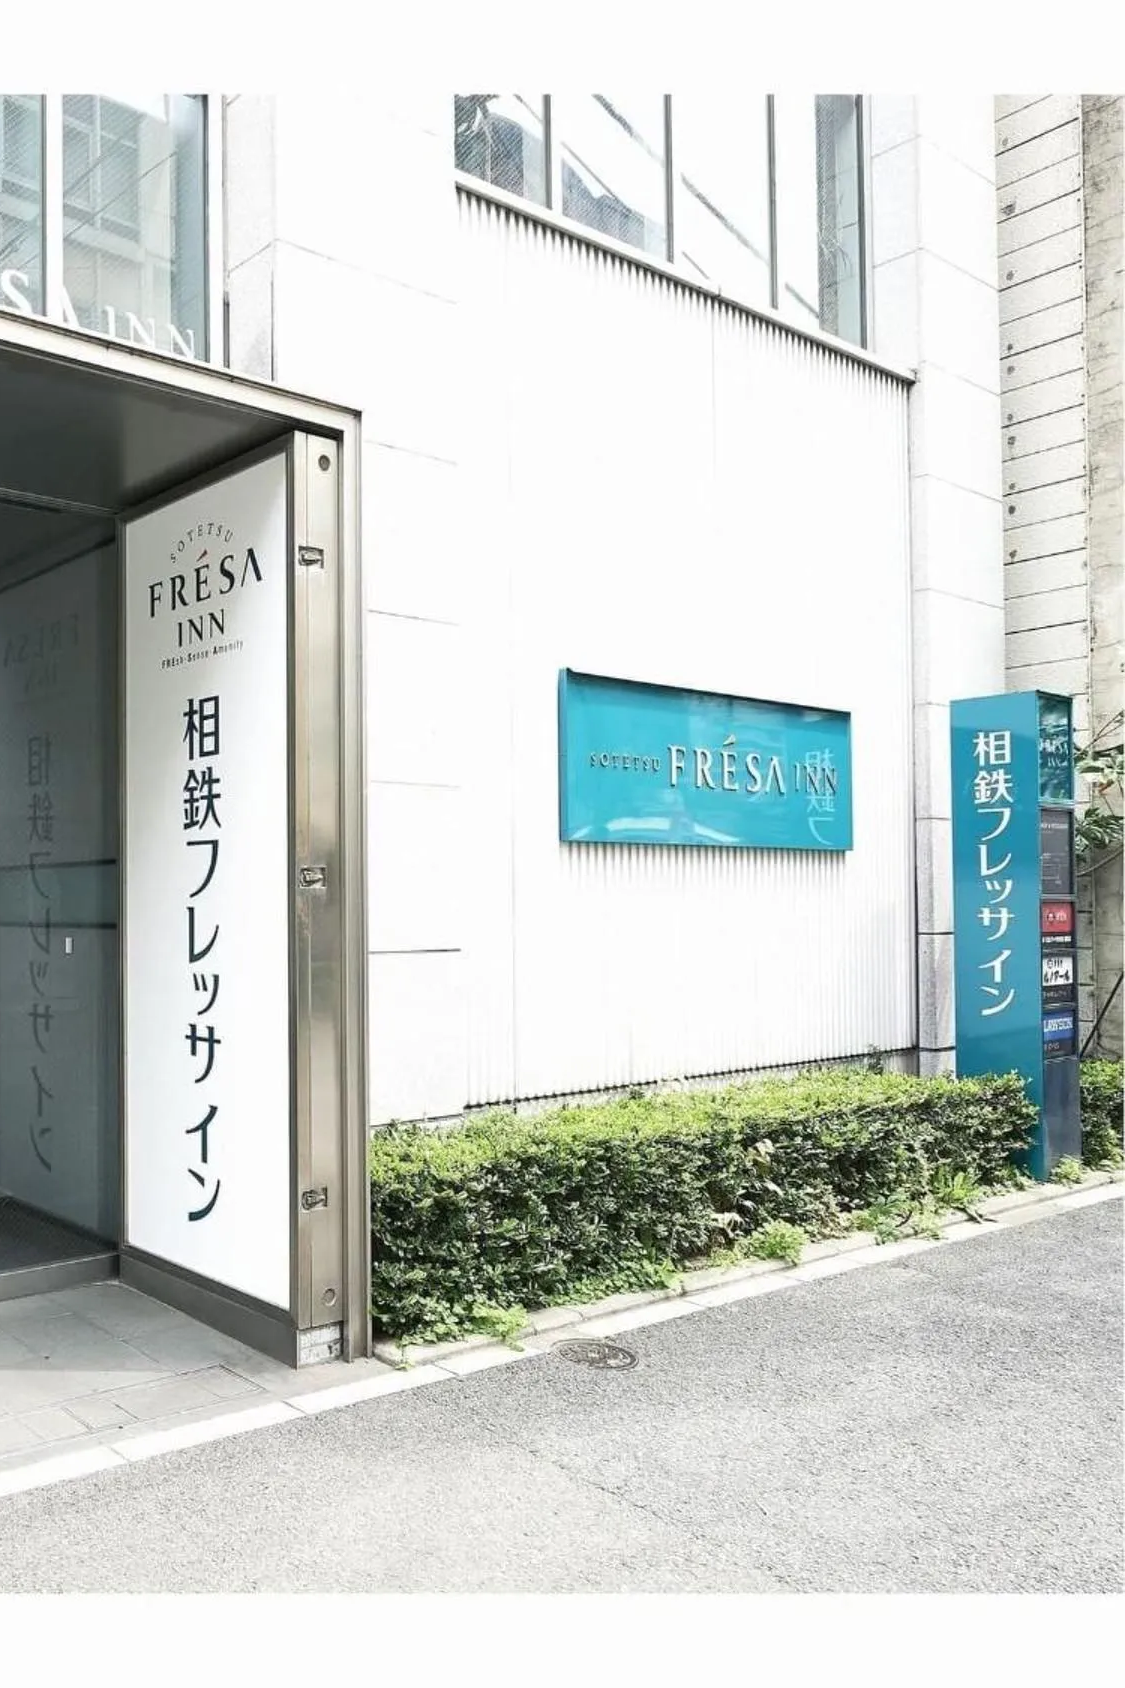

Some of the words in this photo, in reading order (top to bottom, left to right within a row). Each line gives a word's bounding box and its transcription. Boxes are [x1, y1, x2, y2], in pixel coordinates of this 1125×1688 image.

[104, 306, 197, 360] INN
[170, 522, 234, 564] SOTETSU
[147, 547, 264, 619] FRÉSA
[177, 608, 226, 648] INN
[589, 751, 661, 772] SOTETSU
[667, 734, 786, 796] FRÉSA
[794, 762, 838, 795] INN
[973, 730, 1016, 1017] 相鉄フレッサイン
[183, 695, 222, 1222] 相鉄フレッサイン
